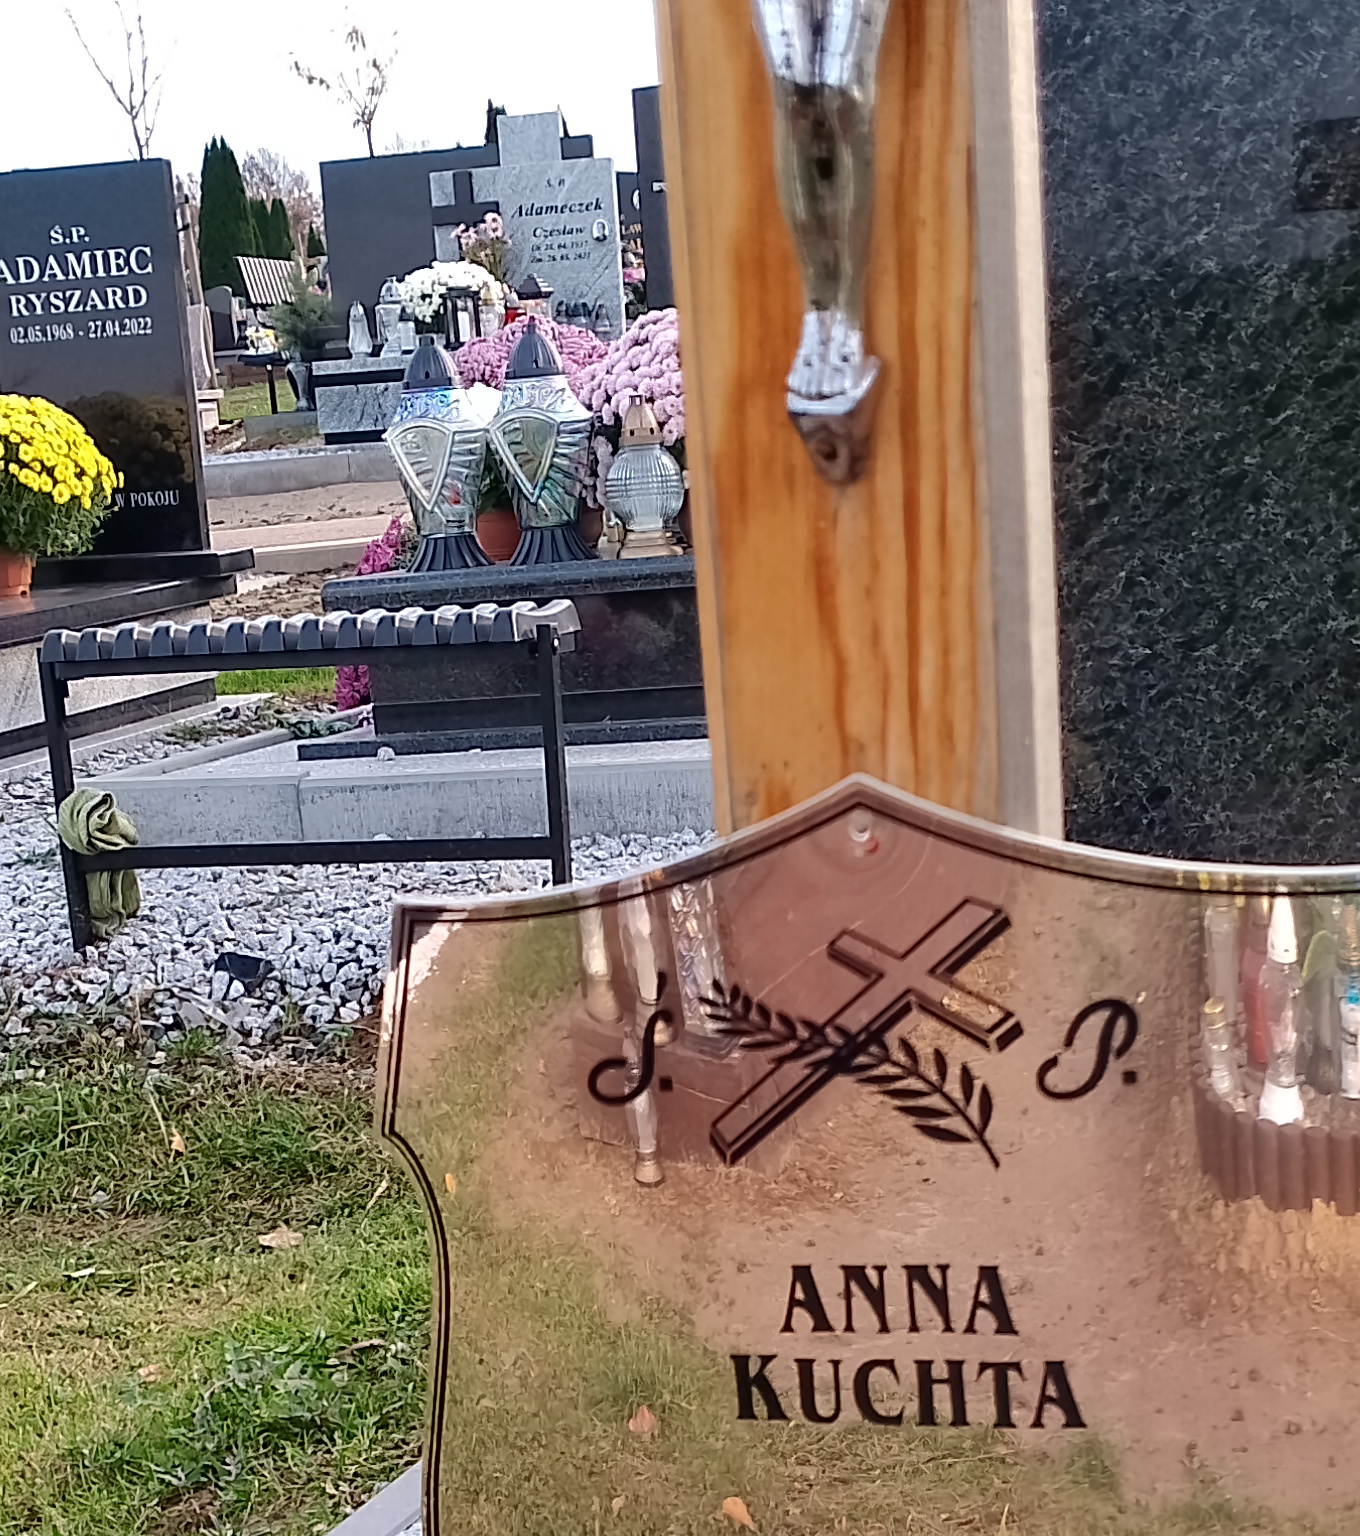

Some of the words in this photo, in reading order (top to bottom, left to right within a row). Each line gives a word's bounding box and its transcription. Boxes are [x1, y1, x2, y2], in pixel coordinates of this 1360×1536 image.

[511, 198, 603, 219] Adameczek
[10, 285, 148, 317] RYSZARD
[10, 323, 74, 344] 02.05.1968
[88, 317, 152, 339] 27.04.2022
[130, 490, 179, 507] POKOJU
[780, 1264, 1019, 1335] ANNA
[730, 1354, 1087, 1429] KUCHTA
